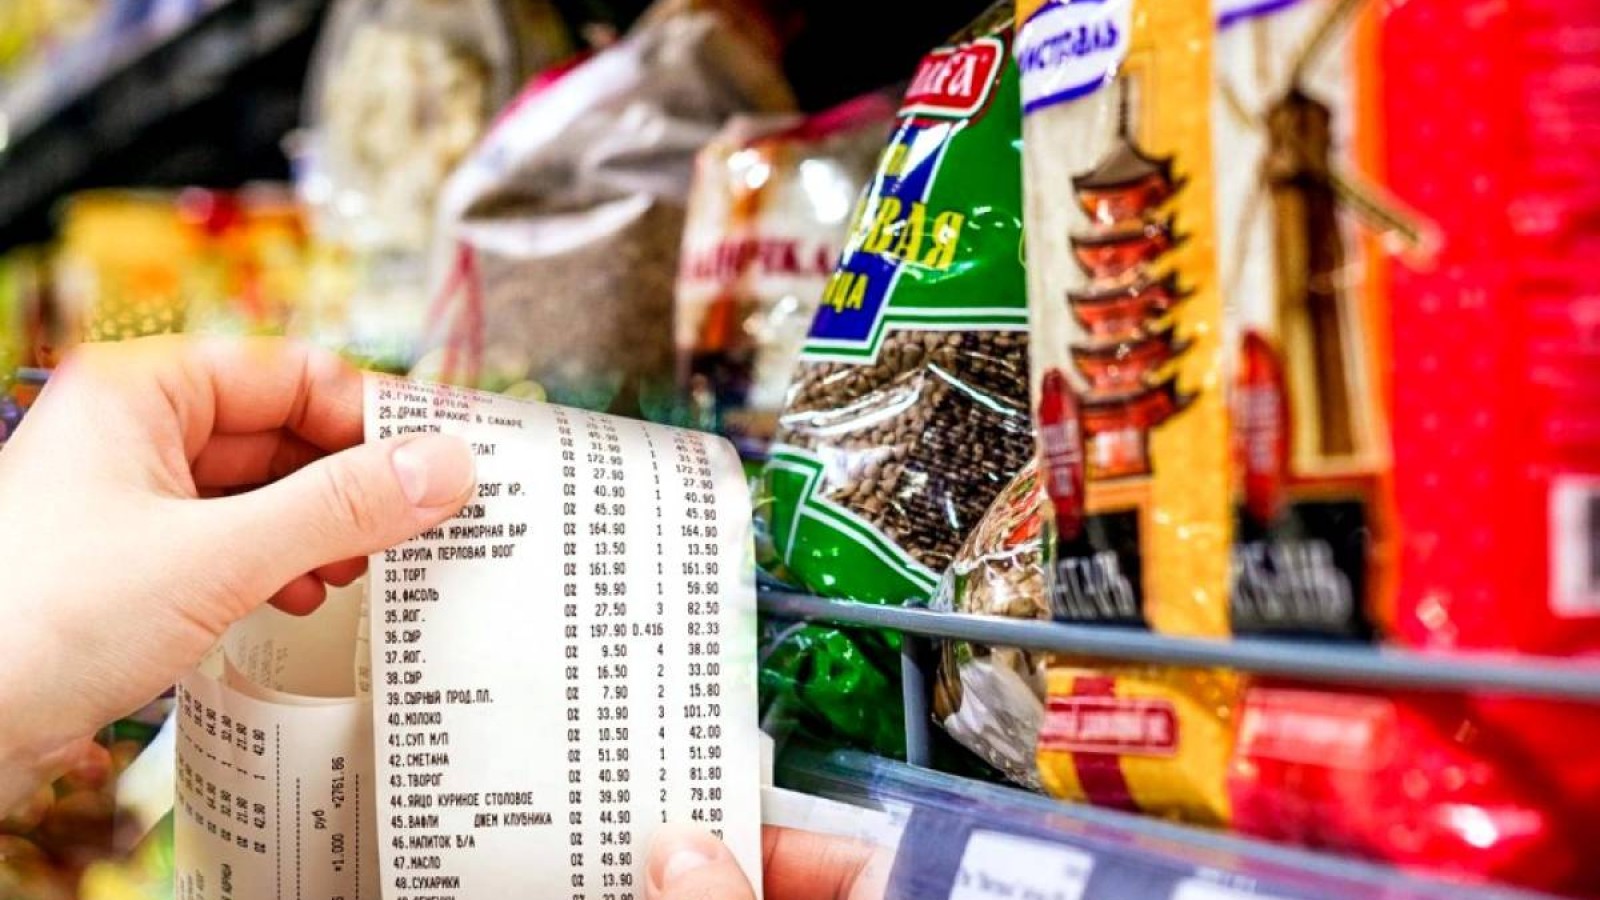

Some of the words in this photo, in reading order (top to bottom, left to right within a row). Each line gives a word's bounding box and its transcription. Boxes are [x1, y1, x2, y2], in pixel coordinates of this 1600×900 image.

[846, 196, 965, 270] ВАЯ
[593, 468, 626, 481] 27.90
[654, 473, 661, 485] 1
[683, 477, 715, 490] 27.90
[478, 483, 504, 498] 250Г
[508, 482, 527, 497] КР.
[593, 485, 626, 498] 40.90
[656, 488, 663, 501] 1
[684, 491, 717, 505] 40.90
[450, 504, 487, 519] ОСУДЫ
[594, 503, 627, 516] 45.90
[656, 505, 664, 518] 1
[686, 508, 718, 521] 45.90
[448, 524, 504, 540] МРАМОРНАЯ
[508, 523, 528, 537] ВАР
[589, 522, 626, 536] 164.90
[657, 523, 664, 537] 1
[681, 525, 718, 538] 164.90
[385, 547, 433, 563] 32.КРУПА
[437, 545, 487, 561] ПЕРЛОВАЯ
[491, 543, 516, 559] 900Г
[595, 541, 627, 556] 13.50
[657, 542, 664, 556] 1
[687, 544, 719, 557] 13.50
[385, 567, 427, 583] 33.ТОРТ
[589, 562, 627, 576] 161.90
[657, 561, 664, 576] 1
[682, 561, 720, 576] 161.90
[385, 588, 440, 604] 34.ФАСОЛЬ
[595, 582, 628, 597] 59.90
[657, 581, 665, 596] 1
[687, 581, 720, 595] 59.90
[595, 602, 628, 617] 27.50
[656, 601, 665, 615] 3
[687, 601, 721, 616] 82.50
[385, 629, 423, 645] 36.СЫР
[591, 623, 627, 639] 197.90
[632, 622, 665, 637] 0.416
[687, 620, 721, 636] 82.33
[601, 643, 628, 658] 9.50
[656, 643, 665, 656] 4
[688, 641, 721, 656] 38.00
[386, 670, 423, 686] 38.СЫР
[597, 664, 629, 679] 16.50
[656, 664, 666, 678] 2
[688, 661, 721, 676] 33.00
[386, 690, 442, 706] 39.СЫРНЫЙ
[446, 689, 495, 705] ПРОД.ПЛ.
[602, 685, 630, 700] 7.90
[657, 684, 666, 698] 2
[689, 682, 722, 698] 15.80
[388, 711, 443, 727] 40.МОЛОКО
[597, 705, 630, 720] 33.90
[657, 704, 666, 719] 3
[683, 703, 722, 719] 101.70
[388, 732, 426, 748] 41.СУП
[429, 731, 450, 746] М/П
[598, 727, 630, 742] 10.50
[658, 725, 666, 740] 4
[688, 724, 722, 740] 42.00
[388, 752, 450, 768] 42.СМЕТАНА
[597, 748, 630, 763] 51.90
[659, 746, 666, 761] 1
[688, 745, 722, 760] 51.90
[389, 772, 445, 788] 43.ТВОРОГ
[598, 768, 631, 784] 40.90
[659, 767, 667, 782] 2
[689, 765, 723, 781] 81.80
[390, 793, 433, 809] 44.ЯЙЦО
[438, 792, 480, 807] КУРИНОЕ
[485, 791, 535, 806] СТОЛОВОЕ
[599, 789, 631, 804] 39.90
[659, 787, 668, 803] 2
[690, 787, 723, 802] 79.80
[390, 814, 440, 830] 45.ВАФЛИ
[474, 812, 499, 829] ДЖЕМ
[504, 811, 553, 828] КЛУБНИКА
[599, 810, 632, 825] 44.90
[660, 809, 668, 824] 1
[691, 808, 724, 823] 44.90
[391, 835, 452, 850] 46.НАПИТОК
[456, 834, 476, 848] Б/А
[600, 830, 632, 845] 34.90
[393, 855, 442, 871] 47.МАСЛО
[601, 852, 633, 867] 49.90
[395, 875, 461, 891] 48.СУХАРИКИ
[603, 872, 634, 888] 13.90
